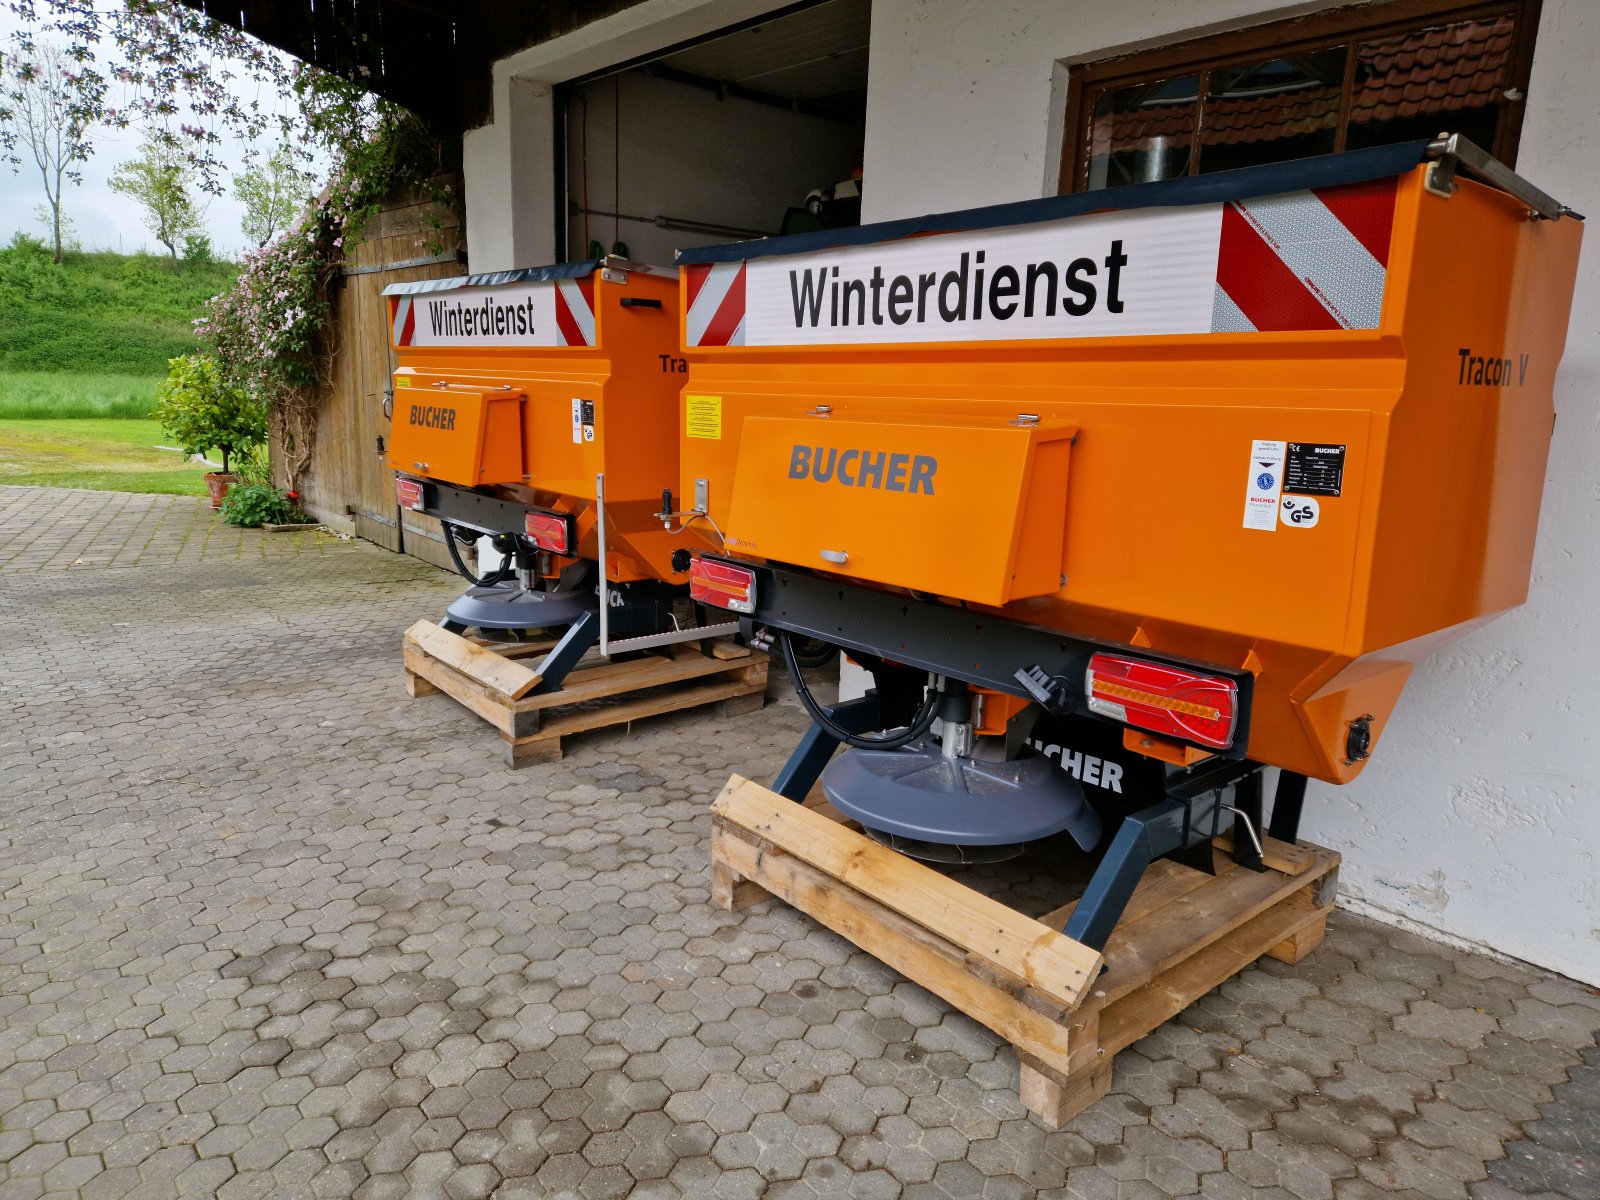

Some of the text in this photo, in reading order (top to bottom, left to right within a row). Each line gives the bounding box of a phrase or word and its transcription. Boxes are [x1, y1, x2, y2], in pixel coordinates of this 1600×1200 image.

[789, 240, 1128, 328] Winterdienst
[429, 296, 535, 337] Winterdienst
[1459, 348, 1529, 387] Tracon V
[410, 404, 456, 431] BUCHER
[788, 444, 938, 496] BUCHER
[1291, 506, 1314, 523] GS
